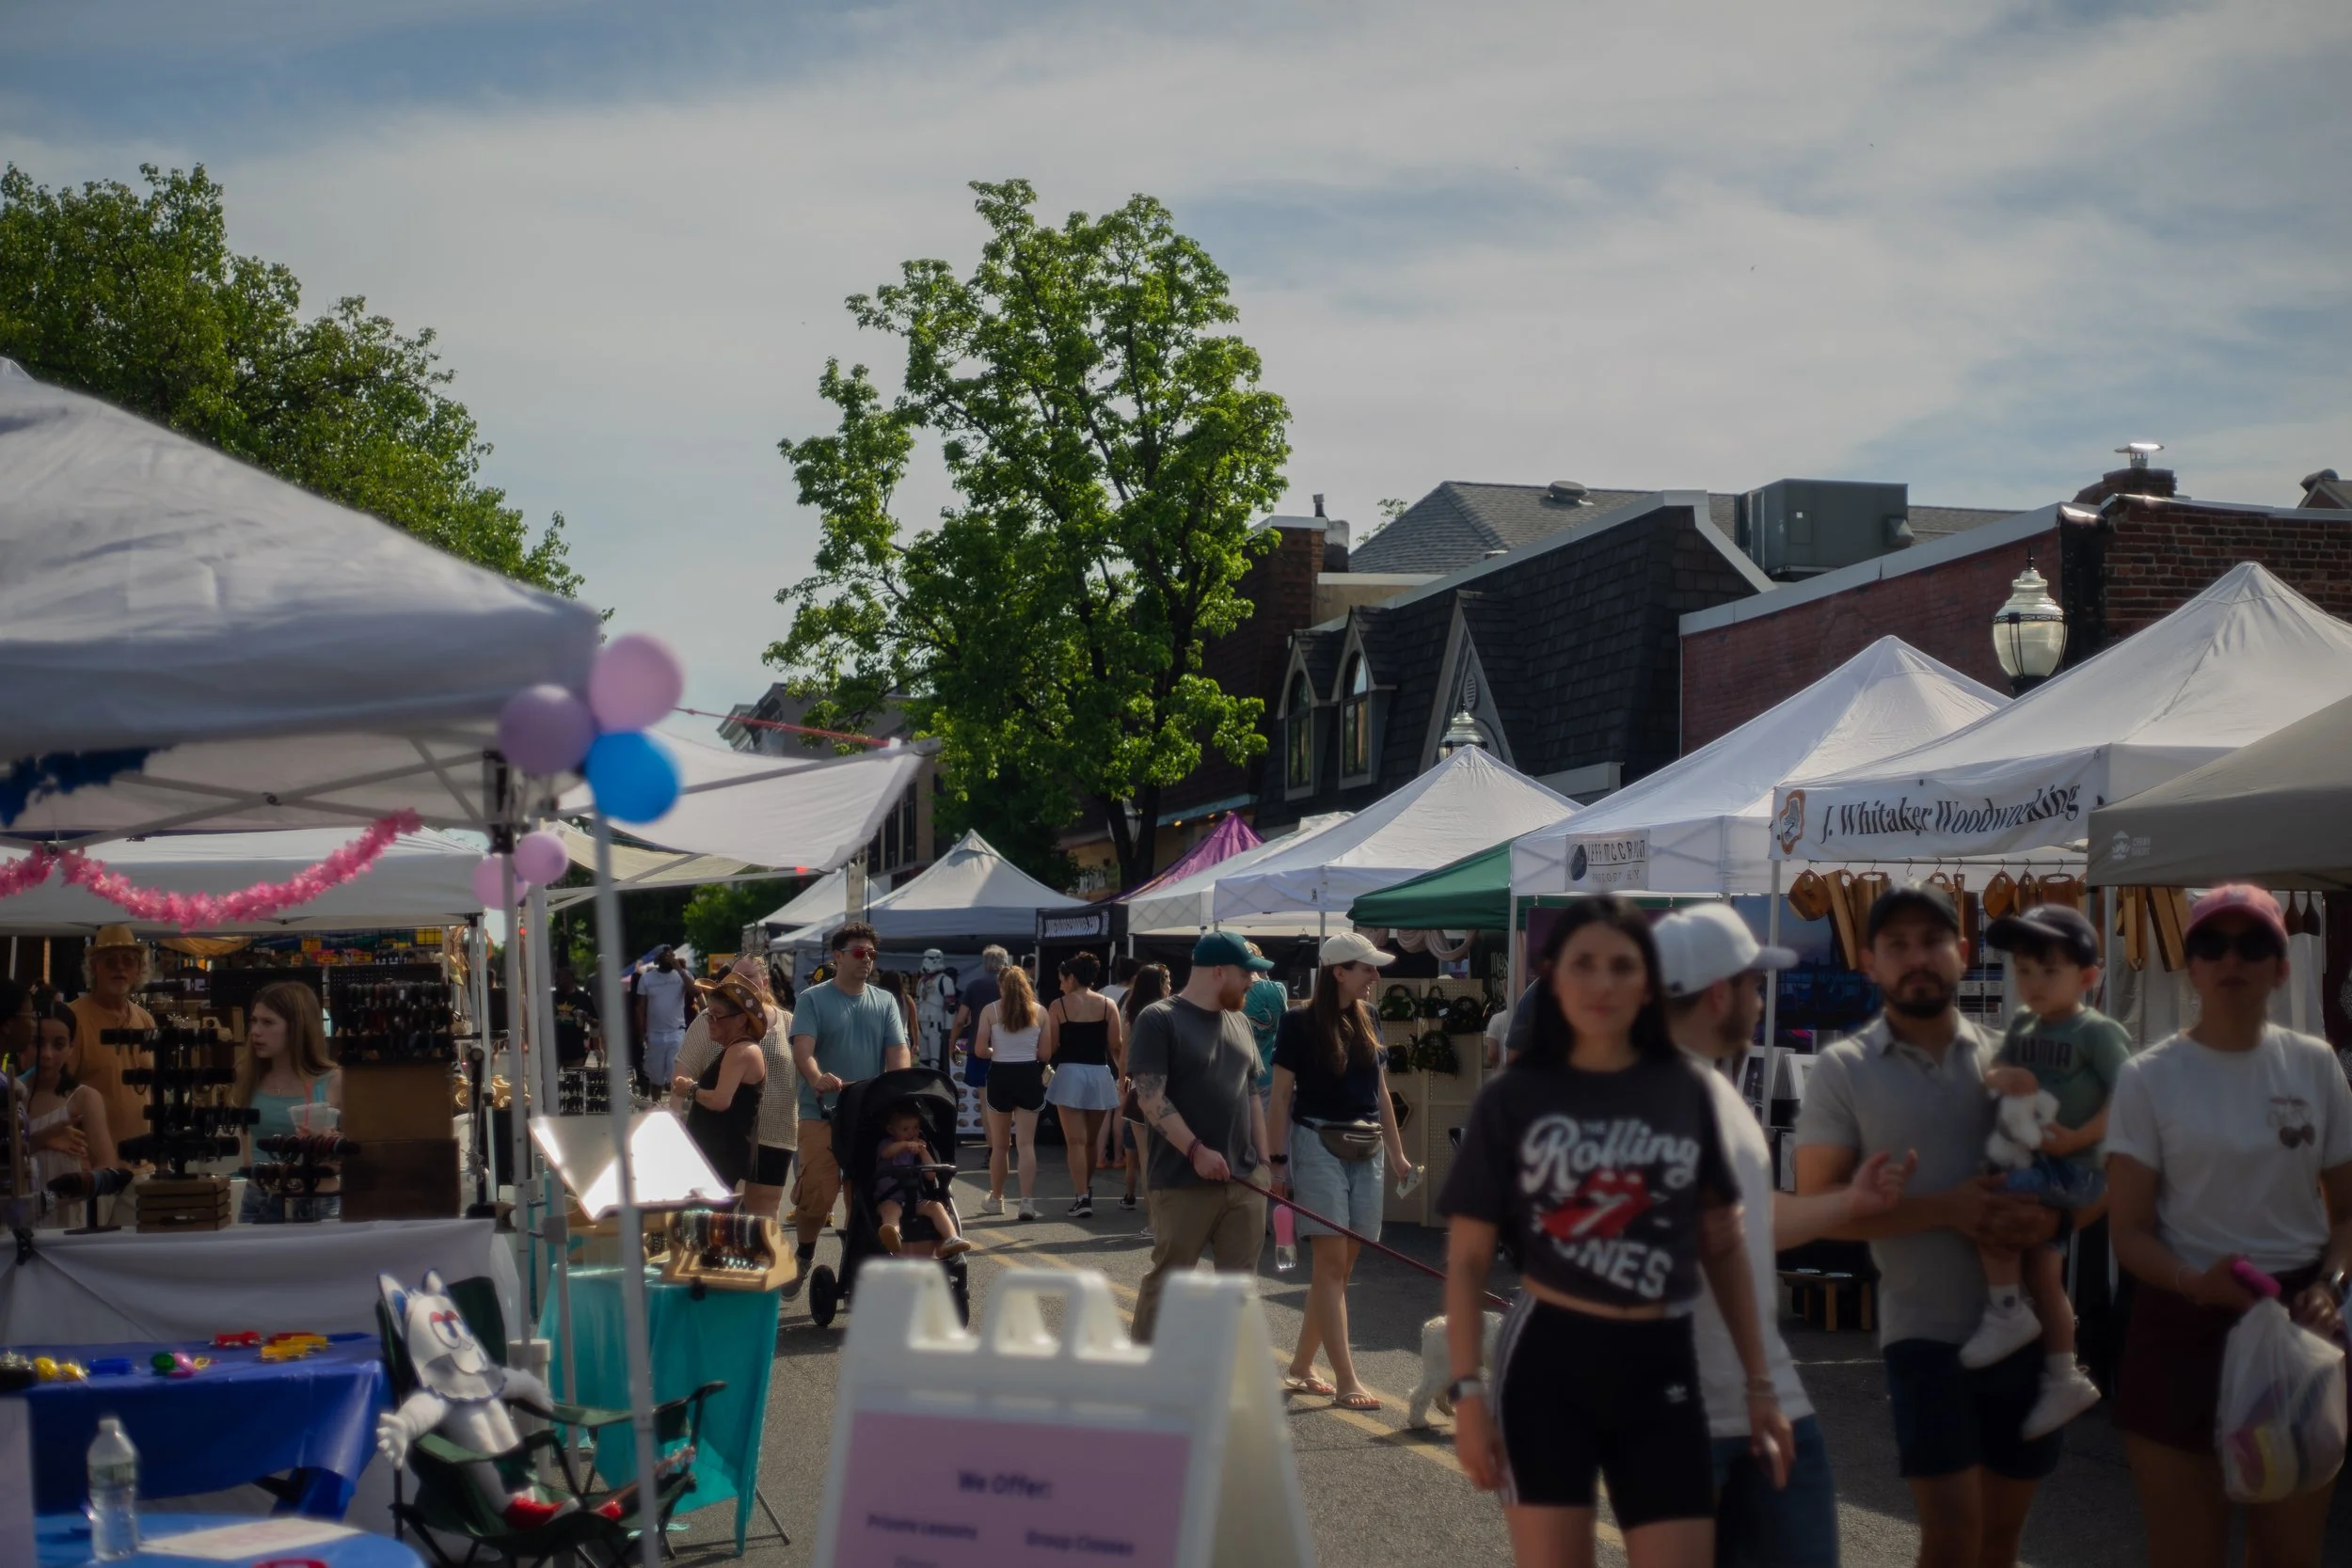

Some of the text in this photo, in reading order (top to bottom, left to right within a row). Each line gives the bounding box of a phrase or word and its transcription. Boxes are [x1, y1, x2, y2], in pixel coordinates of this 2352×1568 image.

[1821, 783, 2081, 845] J. Whitaker Woodworking
[1519, 1114, 1701, 1194] Rolling
